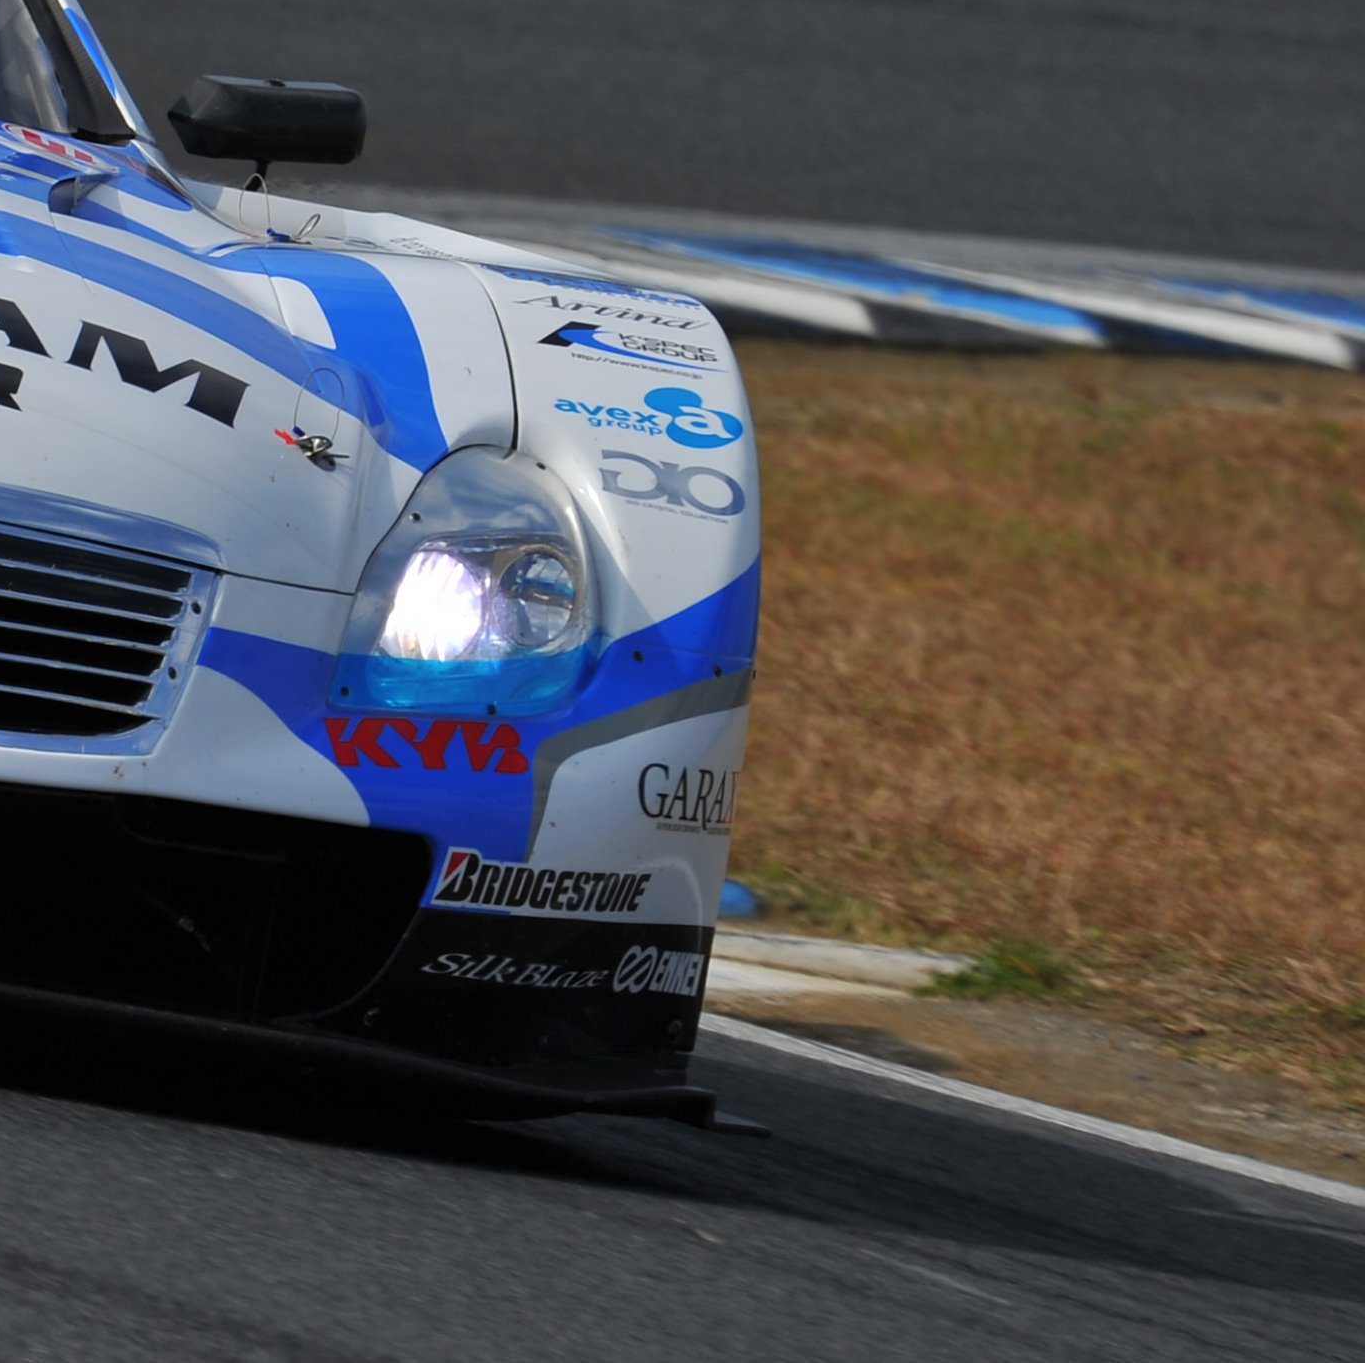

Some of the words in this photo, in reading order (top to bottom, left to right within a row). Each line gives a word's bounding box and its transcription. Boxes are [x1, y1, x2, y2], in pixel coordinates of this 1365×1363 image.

[622, 341, 718, 363] GROUP
[554, 397, 660, 427] avex
[587, 415, 664, 436] group
[324, 717, 529, 774] KYB
[434, 850, 652, 913] BRIDGESTONE
[648, 950, 706, 997] ENKEI
